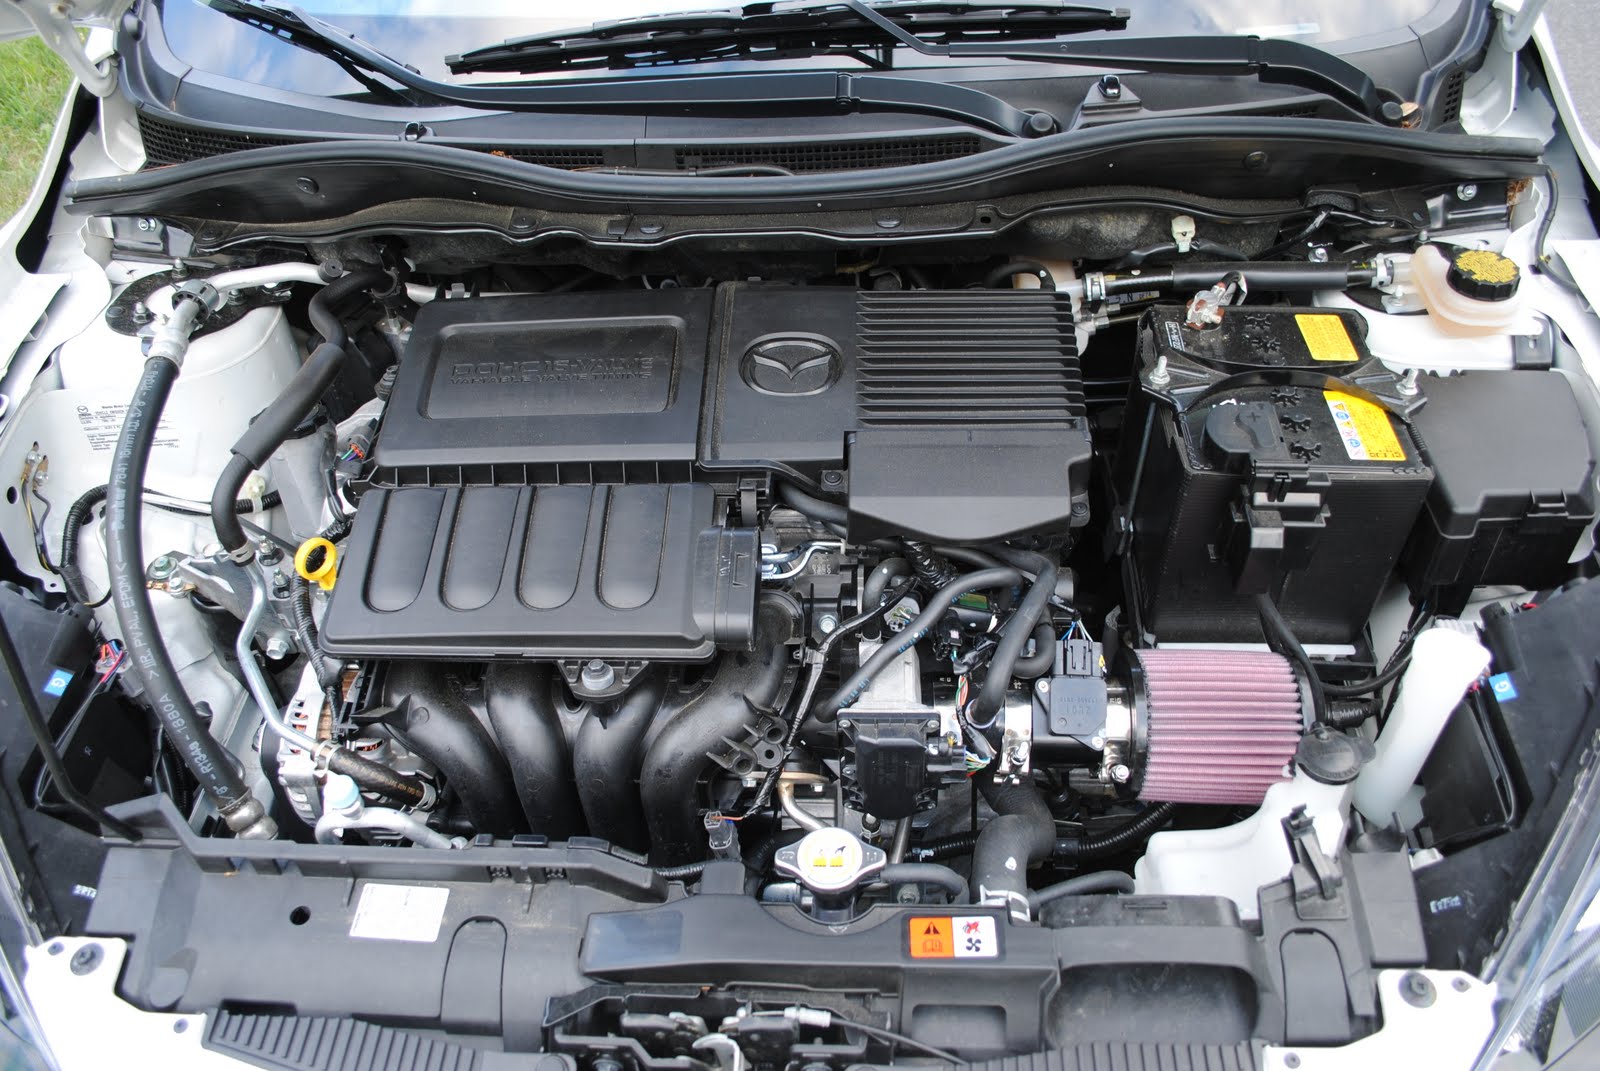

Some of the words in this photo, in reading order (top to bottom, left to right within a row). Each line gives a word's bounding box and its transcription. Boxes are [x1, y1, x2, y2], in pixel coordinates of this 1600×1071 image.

[452, 360, 541, 376] DOHC
[450, 374, 532, 385] VARIABLE
[536, 372, 589, 383] VALVE
